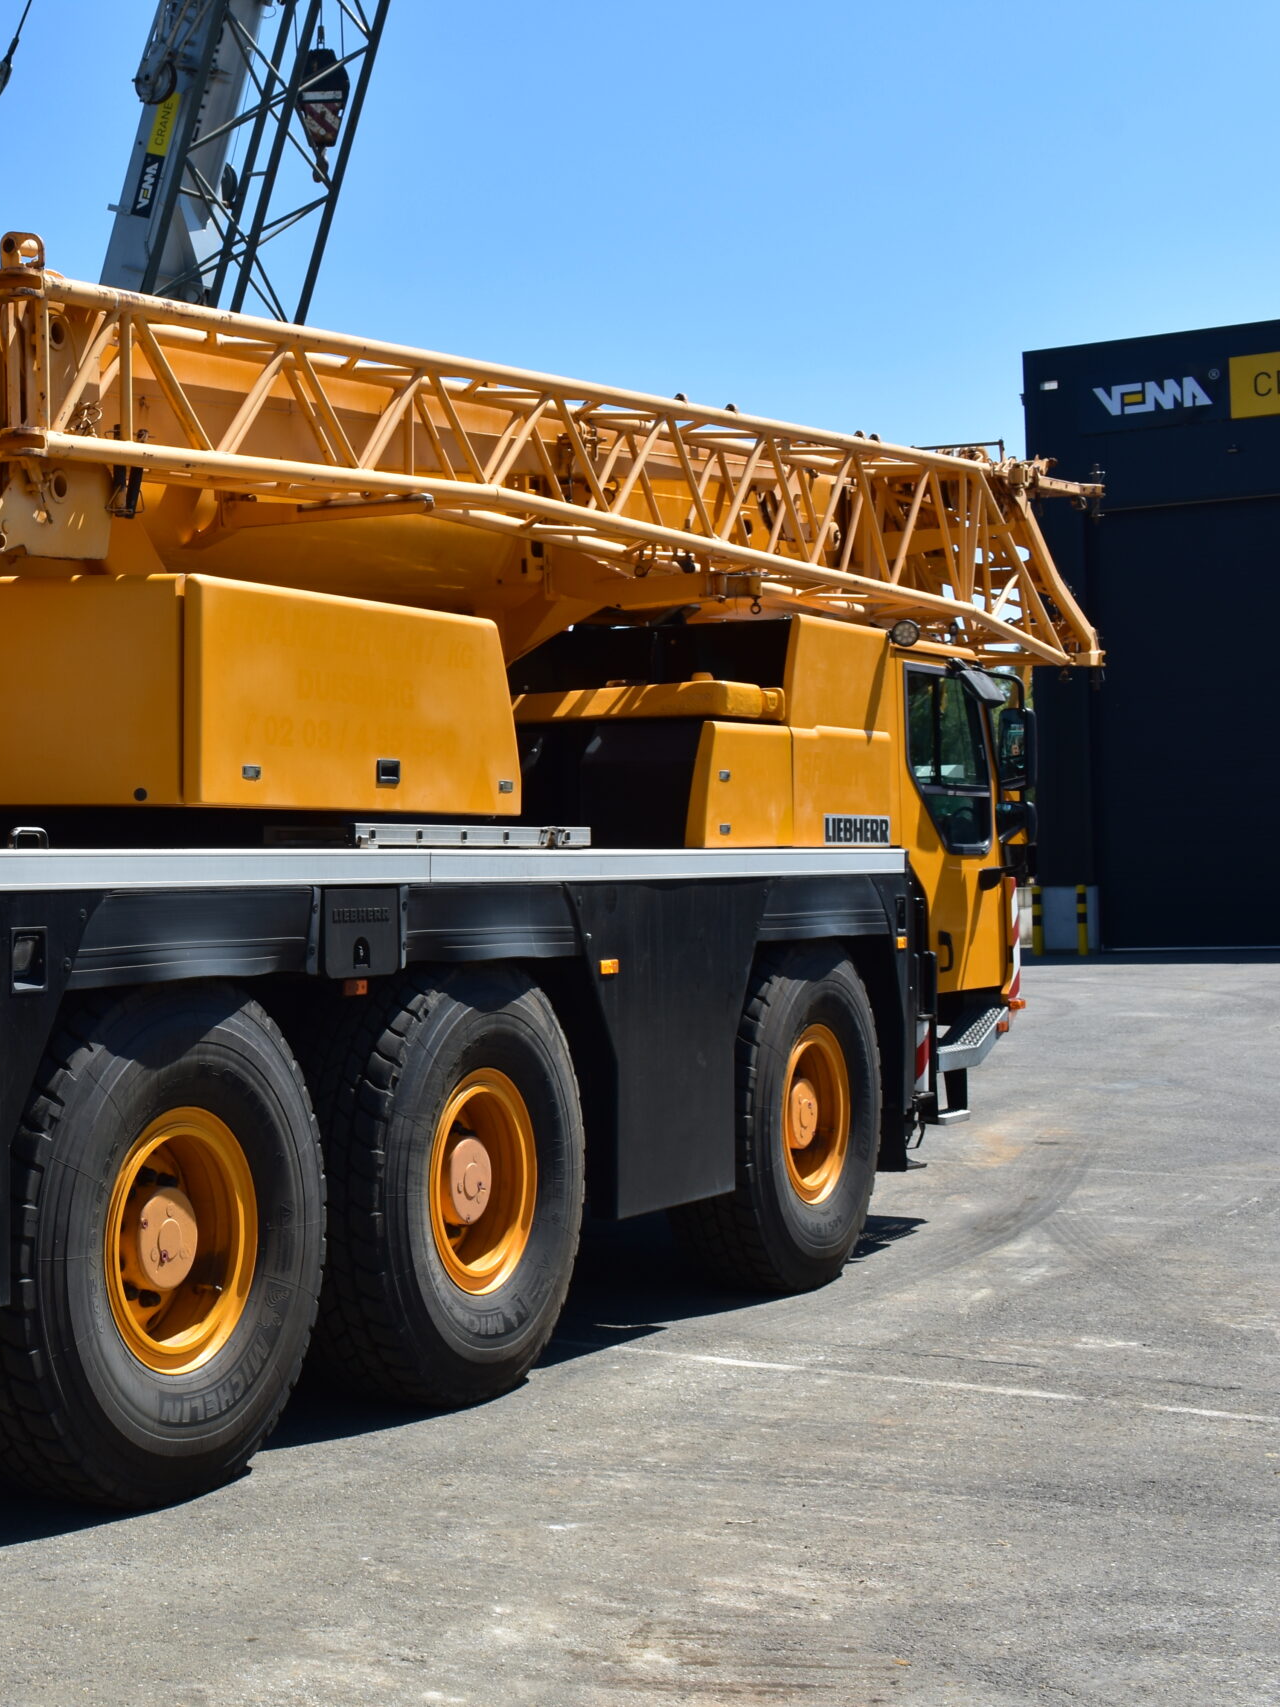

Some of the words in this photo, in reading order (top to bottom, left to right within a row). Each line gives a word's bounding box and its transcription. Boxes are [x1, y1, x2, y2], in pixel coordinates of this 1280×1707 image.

[154, 102, 174, 146] CRANE
[825, 818, 889, 843] LIEBHERR
[332, 908, 391, 924] LIEBHERR
[160, 1333, 271, 1423] MICHELIN
